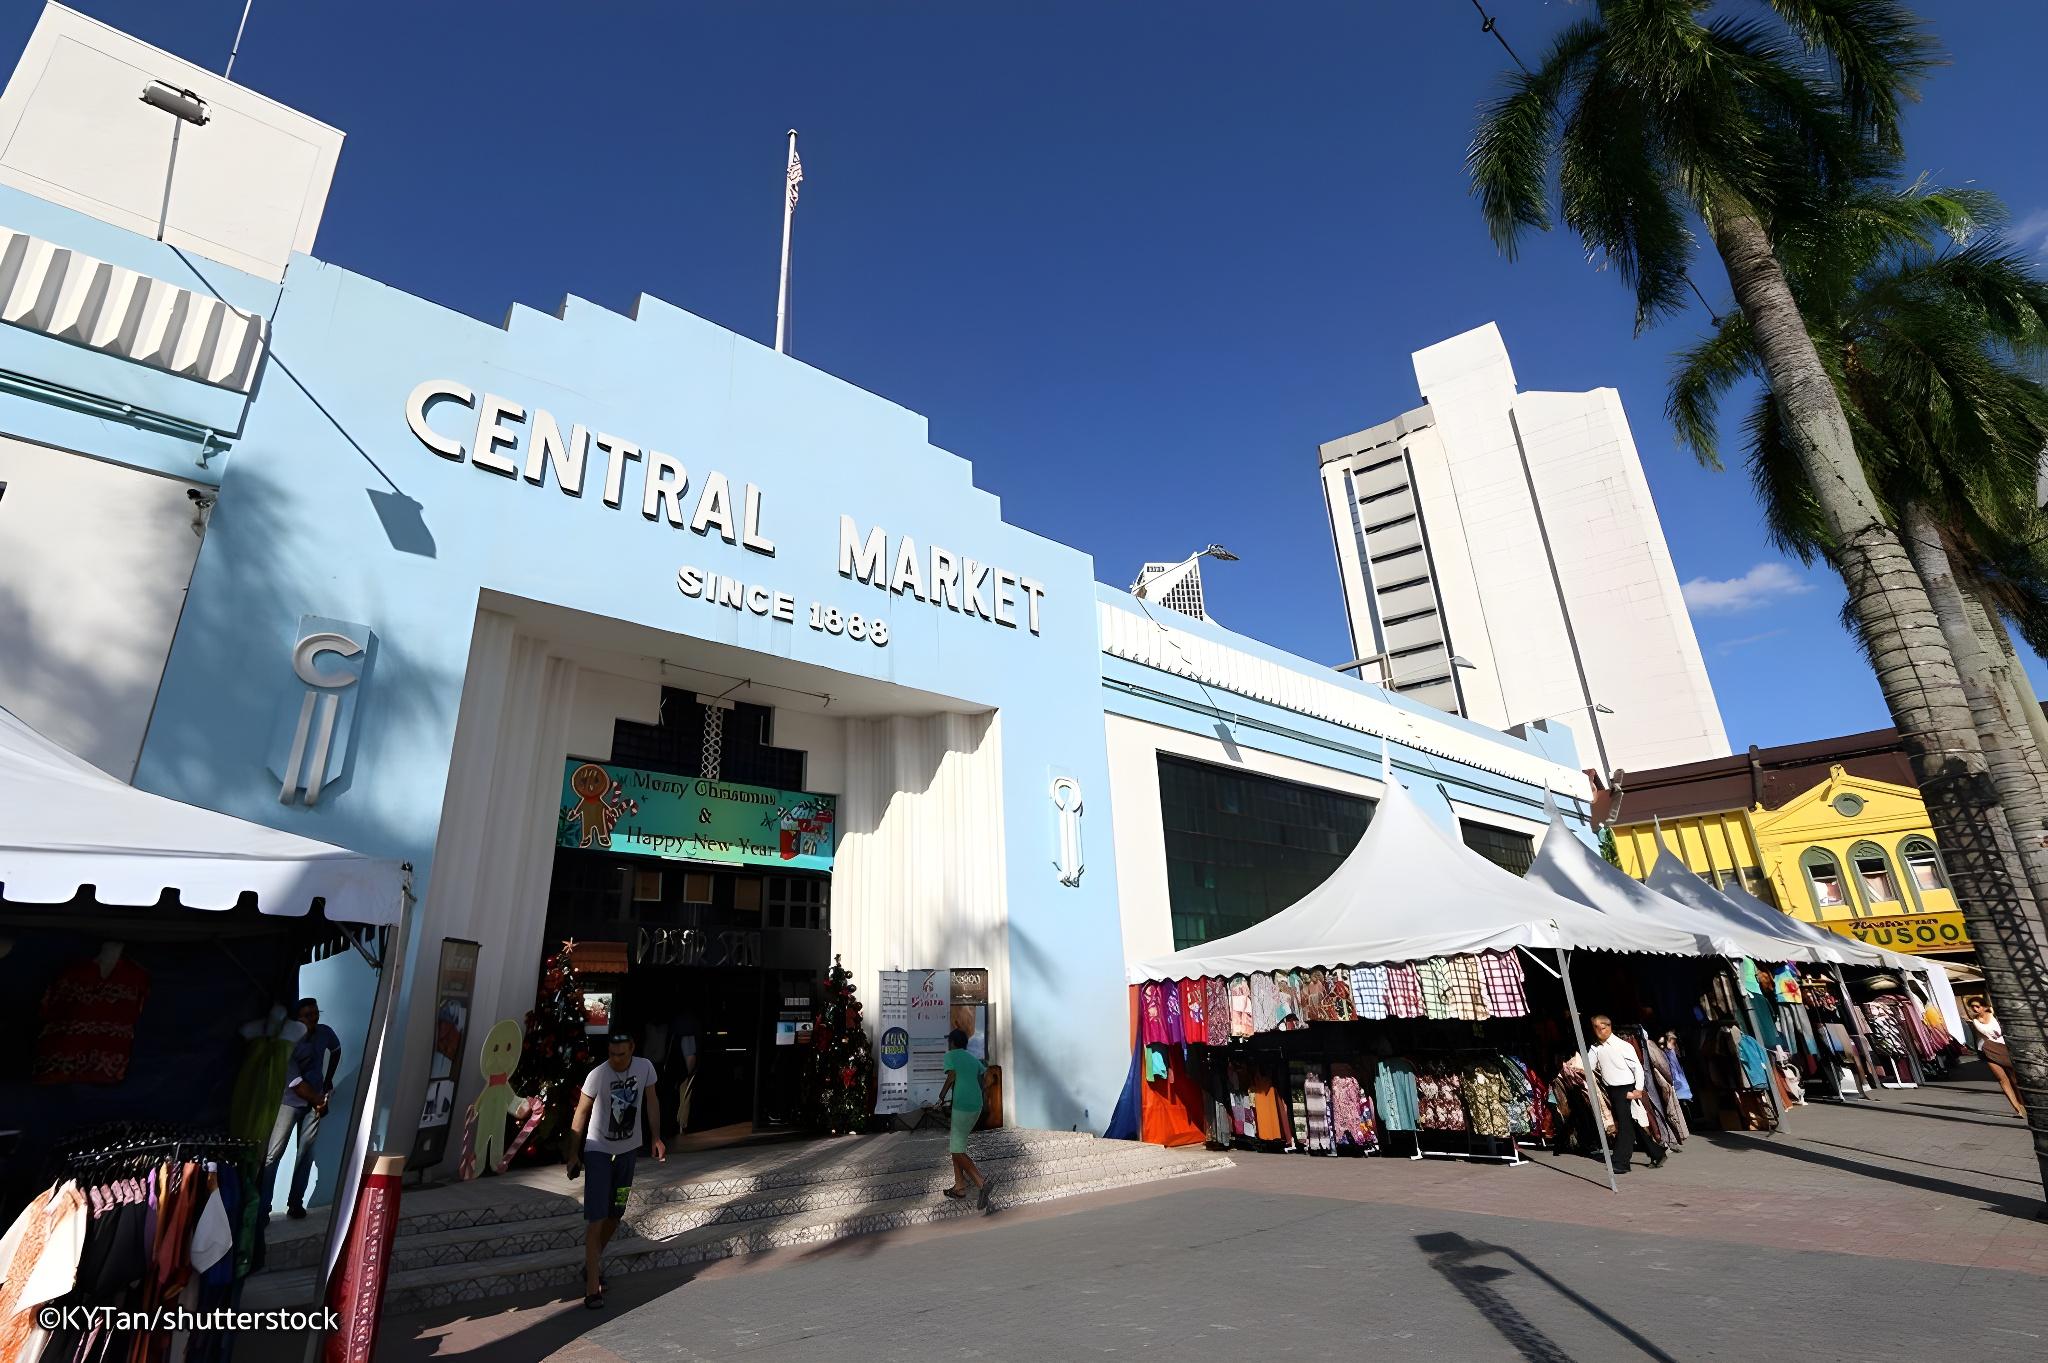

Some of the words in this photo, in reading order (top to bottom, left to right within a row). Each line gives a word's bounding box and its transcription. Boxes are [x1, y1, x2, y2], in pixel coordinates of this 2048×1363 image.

[404, 379, 775, 558] CENTRAL
[838, 514, 1045, 637] MARKET
[676, 565, 795, 625] SINCE
[627, 826, 687, 856] Happy
[693, 833, 730, 852] New
[1852, 924, 1971, 944] YUSOO
